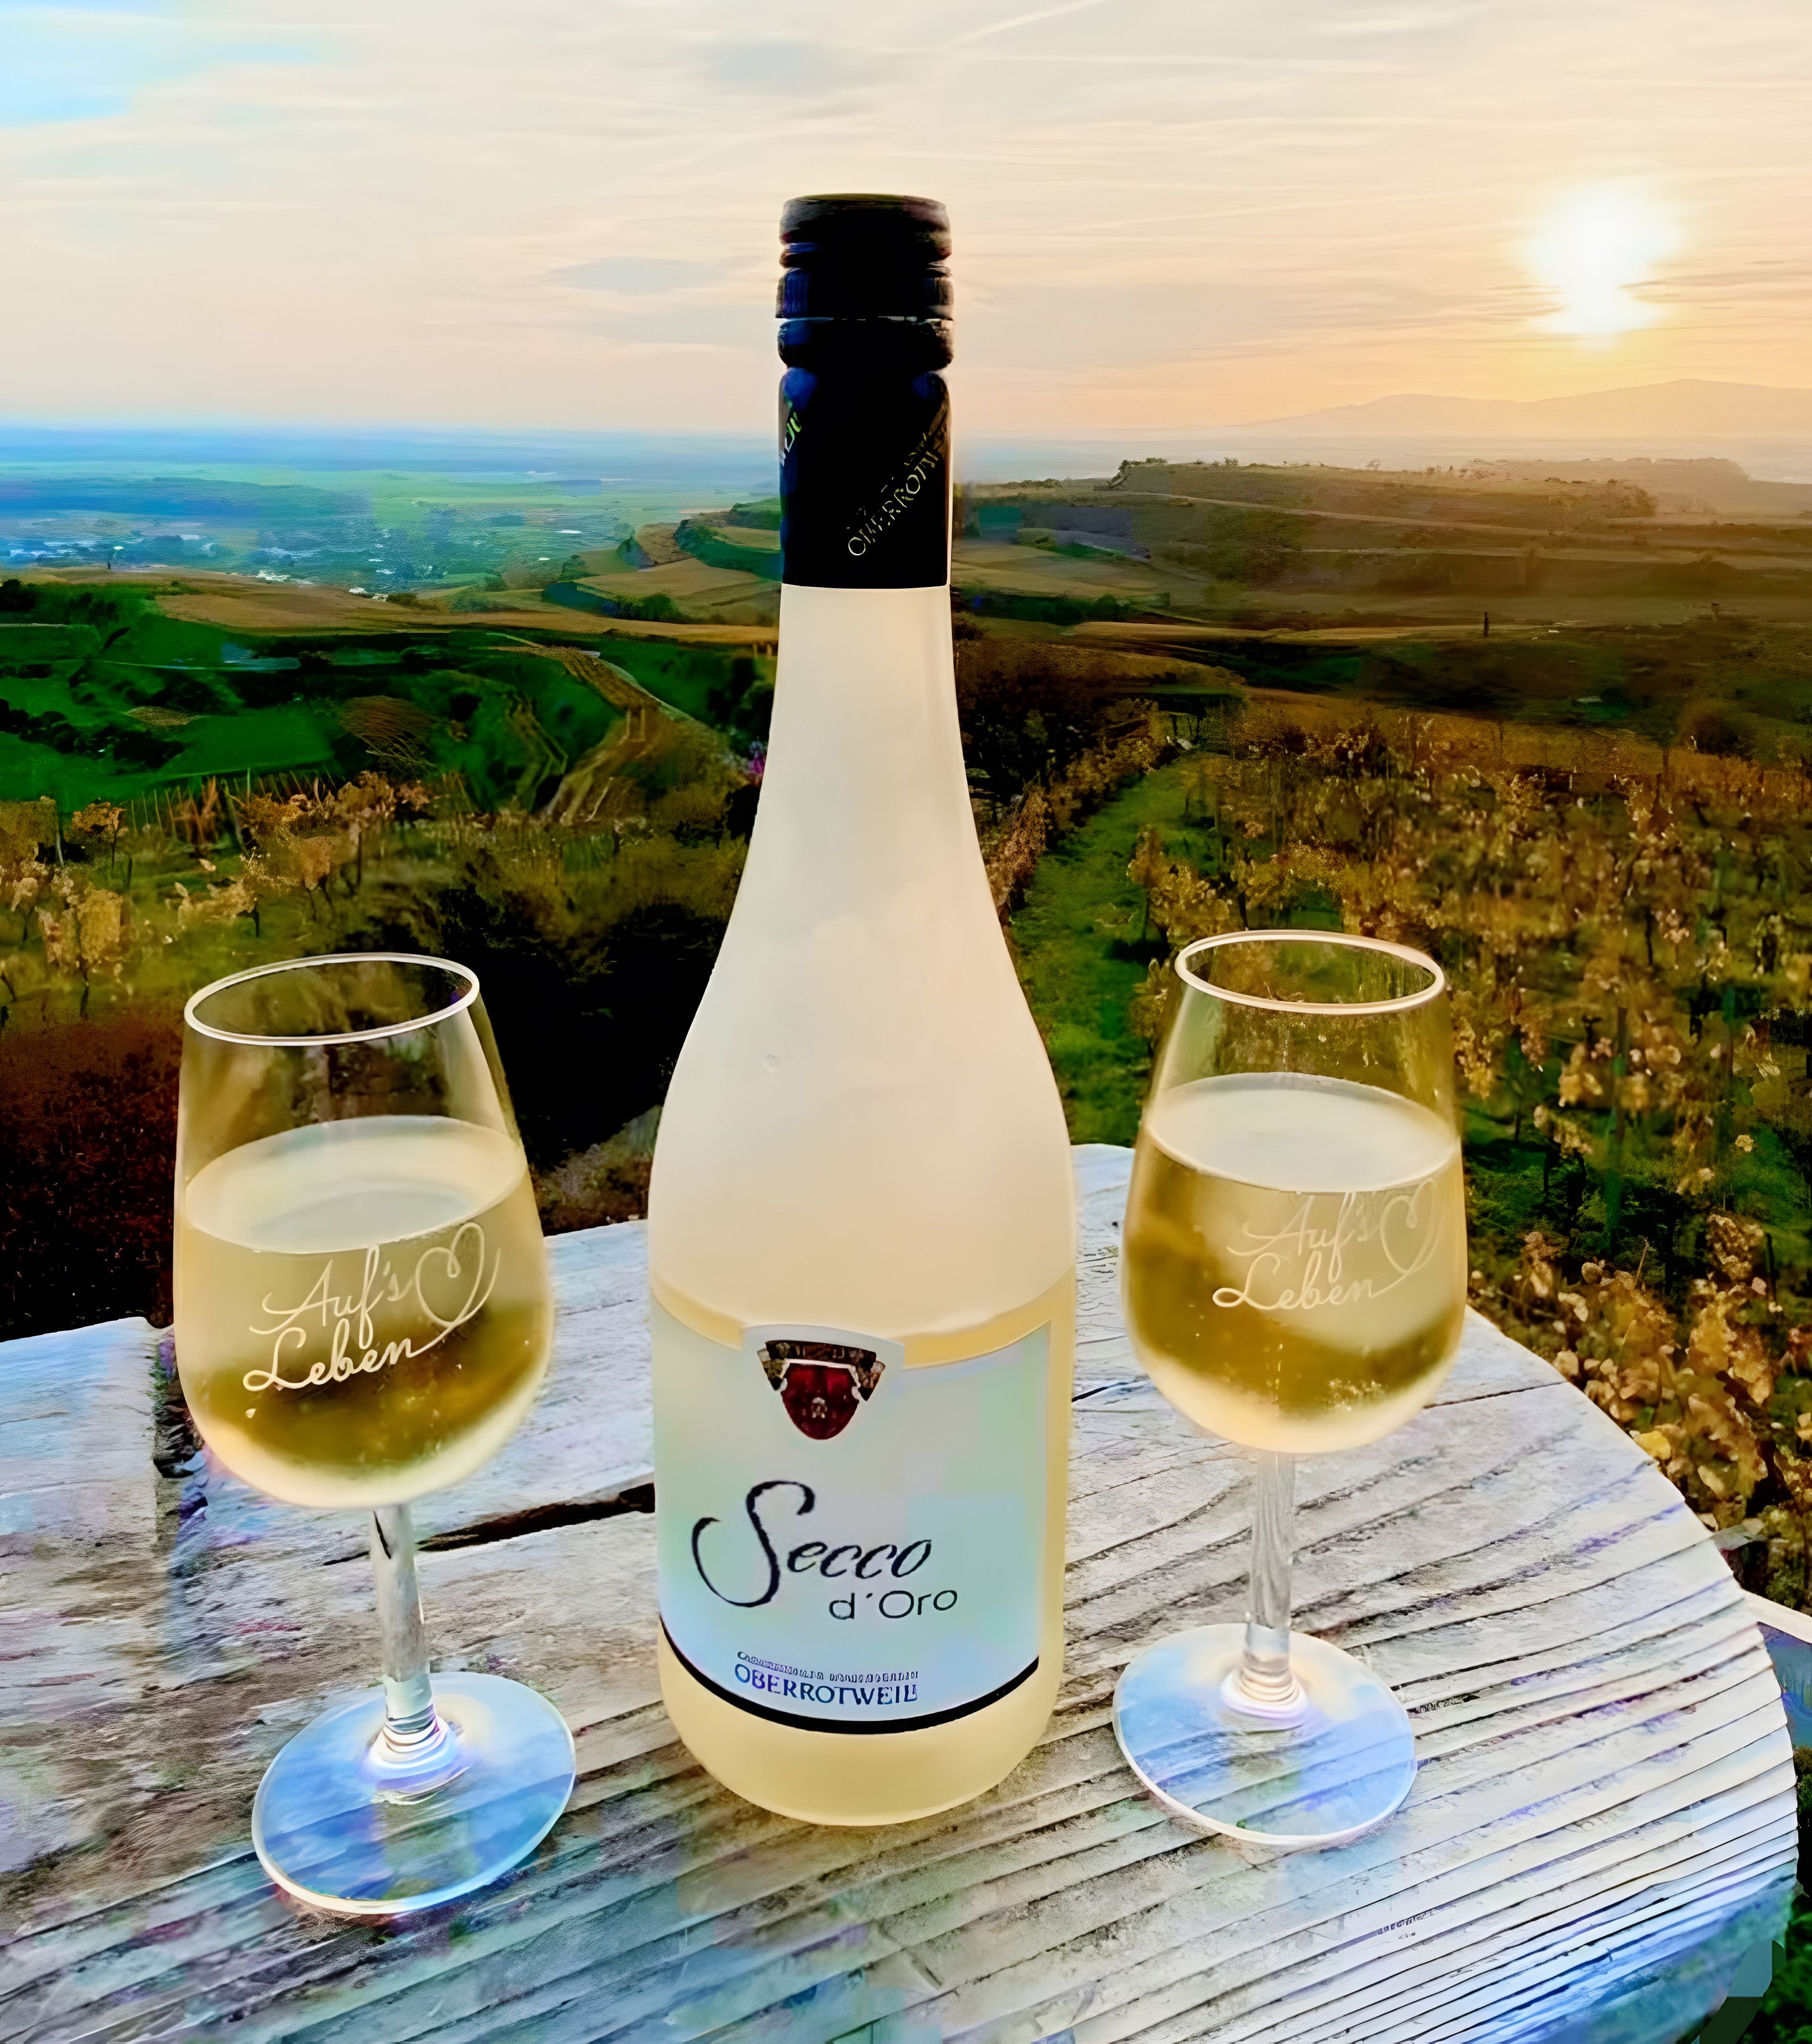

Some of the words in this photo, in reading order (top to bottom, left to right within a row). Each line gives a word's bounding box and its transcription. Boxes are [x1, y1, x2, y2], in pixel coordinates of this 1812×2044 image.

[249, 1244, 415, 1350] Auf's
[1212, 1250, 1376, 1310] Leben
[243, 1318, 418, 1391] Leben
[691, 1480, 932, 1608] Secco
[735, 1663, 918, 1705] OBERROTWEIL
